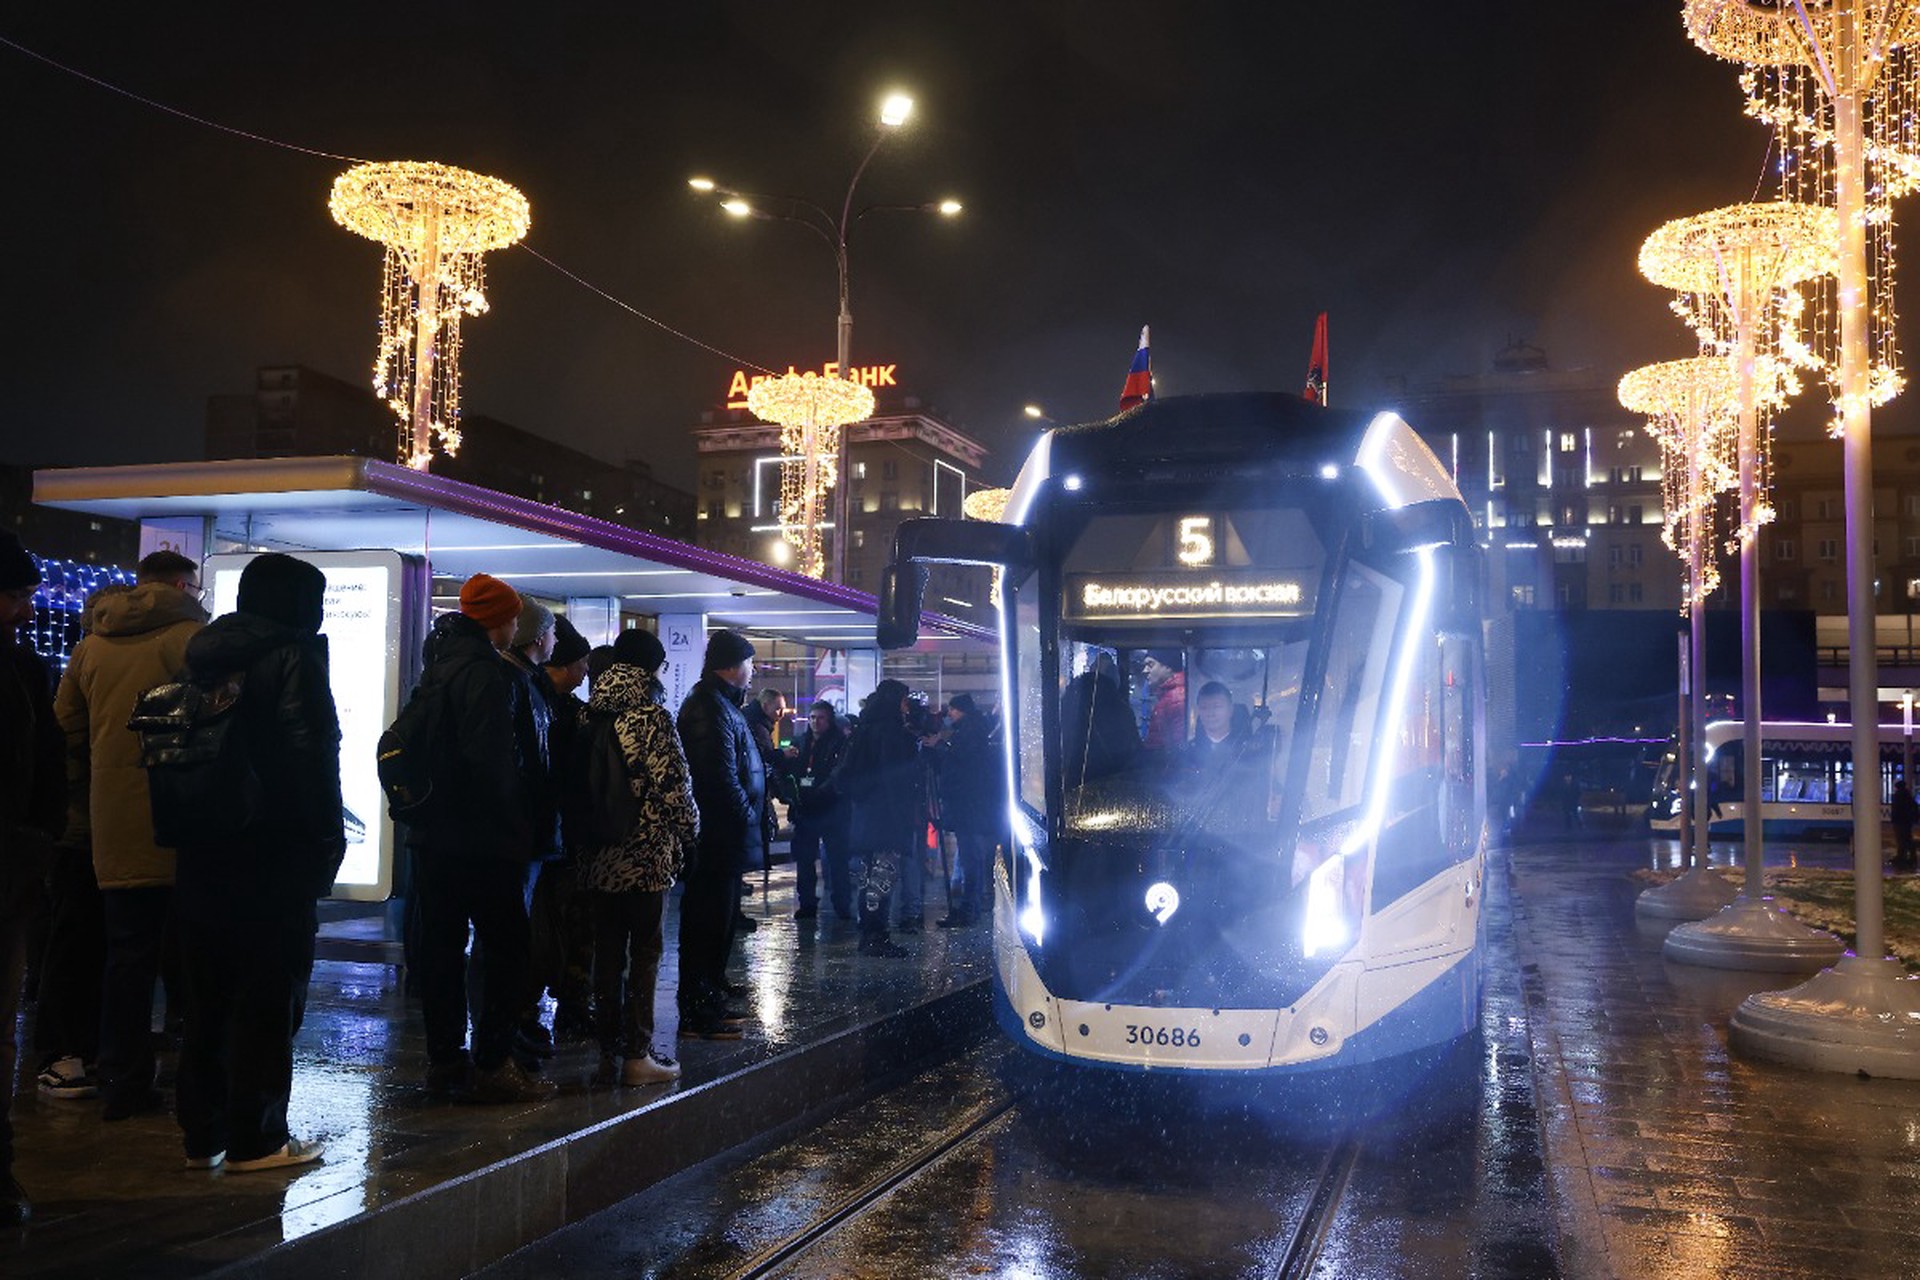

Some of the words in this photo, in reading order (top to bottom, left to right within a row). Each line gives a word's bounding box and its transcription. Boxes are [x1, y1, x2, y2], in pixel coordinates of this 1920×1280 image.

[1179, 517, 1212, 563] 5
[1083, 582, 1223, 609] Белорусский
[1225, 583, 1299, 603] вокзал
[1125, 1024, 1201, 1048] 30686
